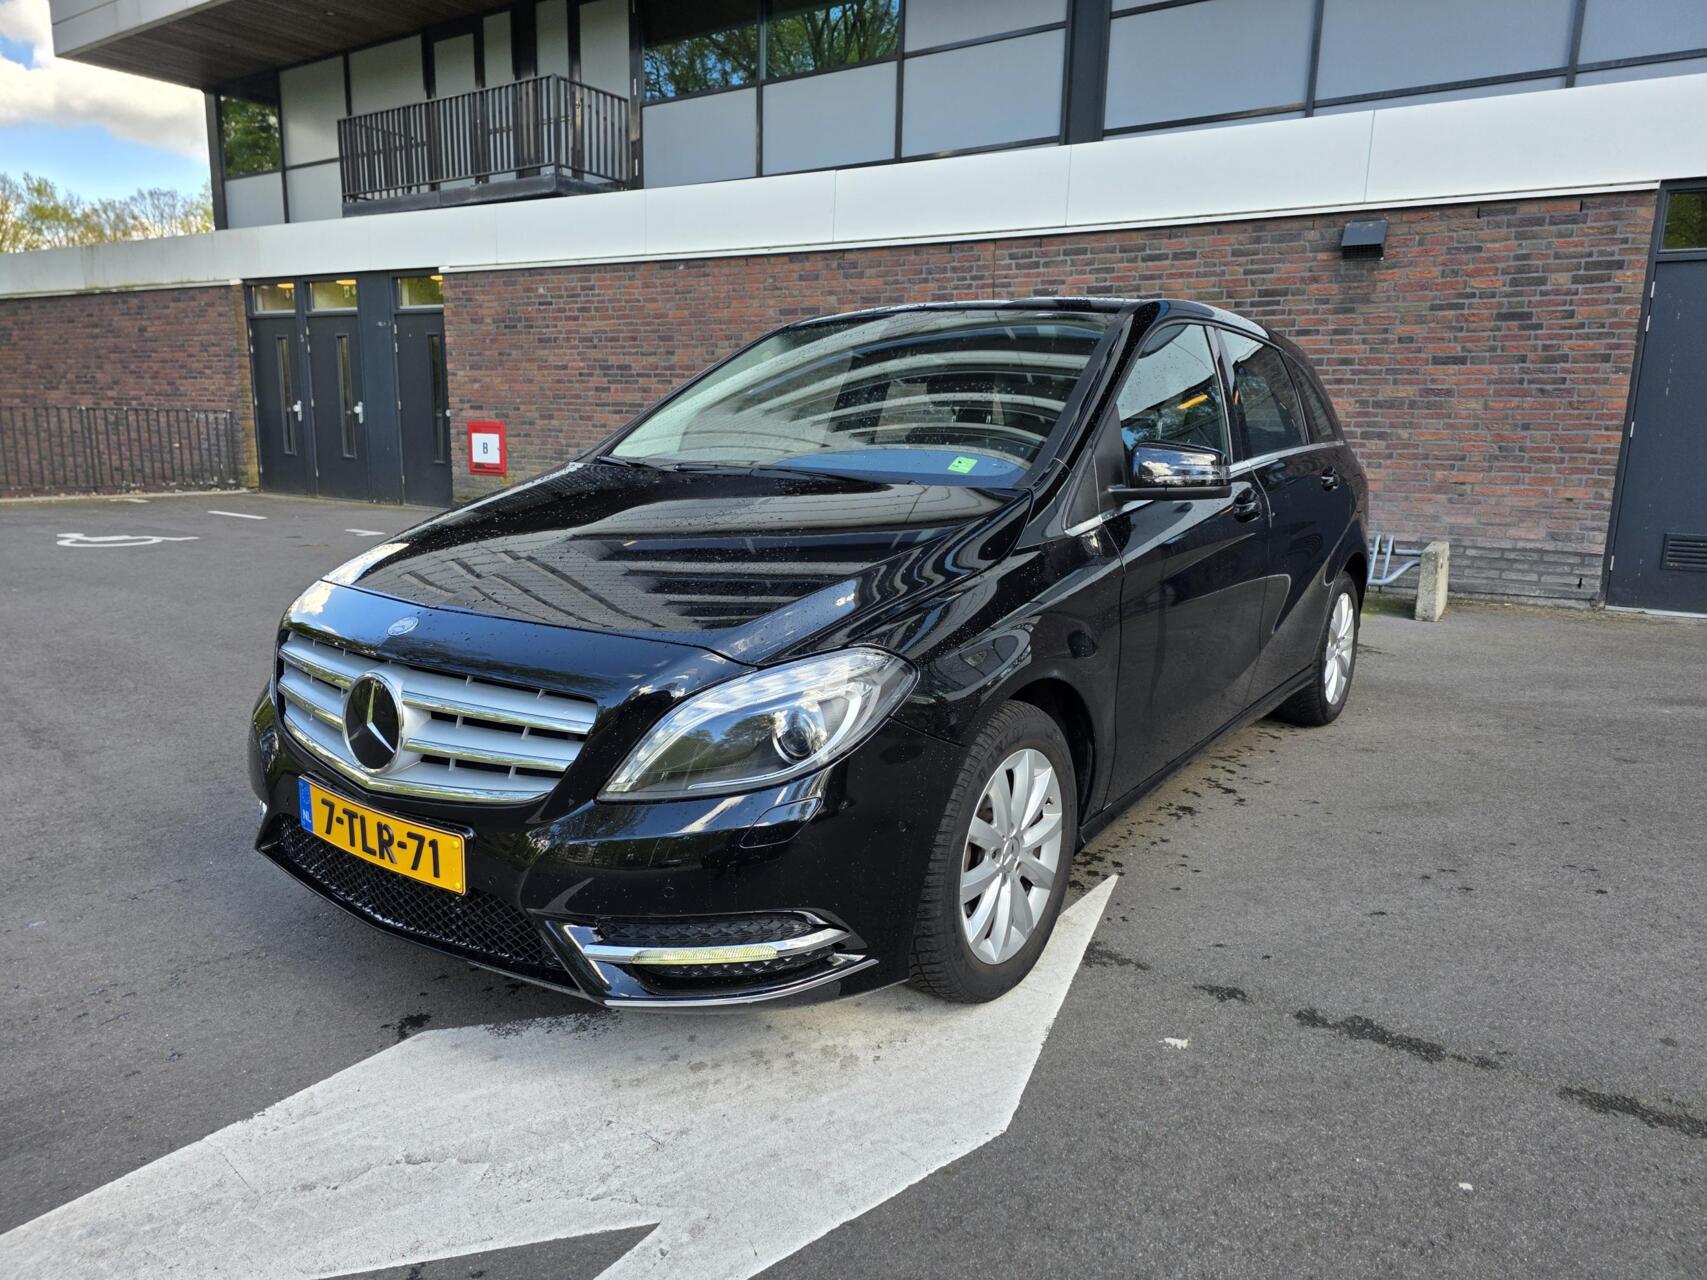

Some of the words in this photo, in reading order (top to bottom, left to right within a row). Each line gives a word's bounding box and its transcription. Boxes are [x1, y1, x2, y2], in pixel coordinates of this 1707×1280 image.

[482, 442, 489, 455] B
[302, 808, 312, 824] NL
[320, 797, 441, 879] 7-TLR-71
